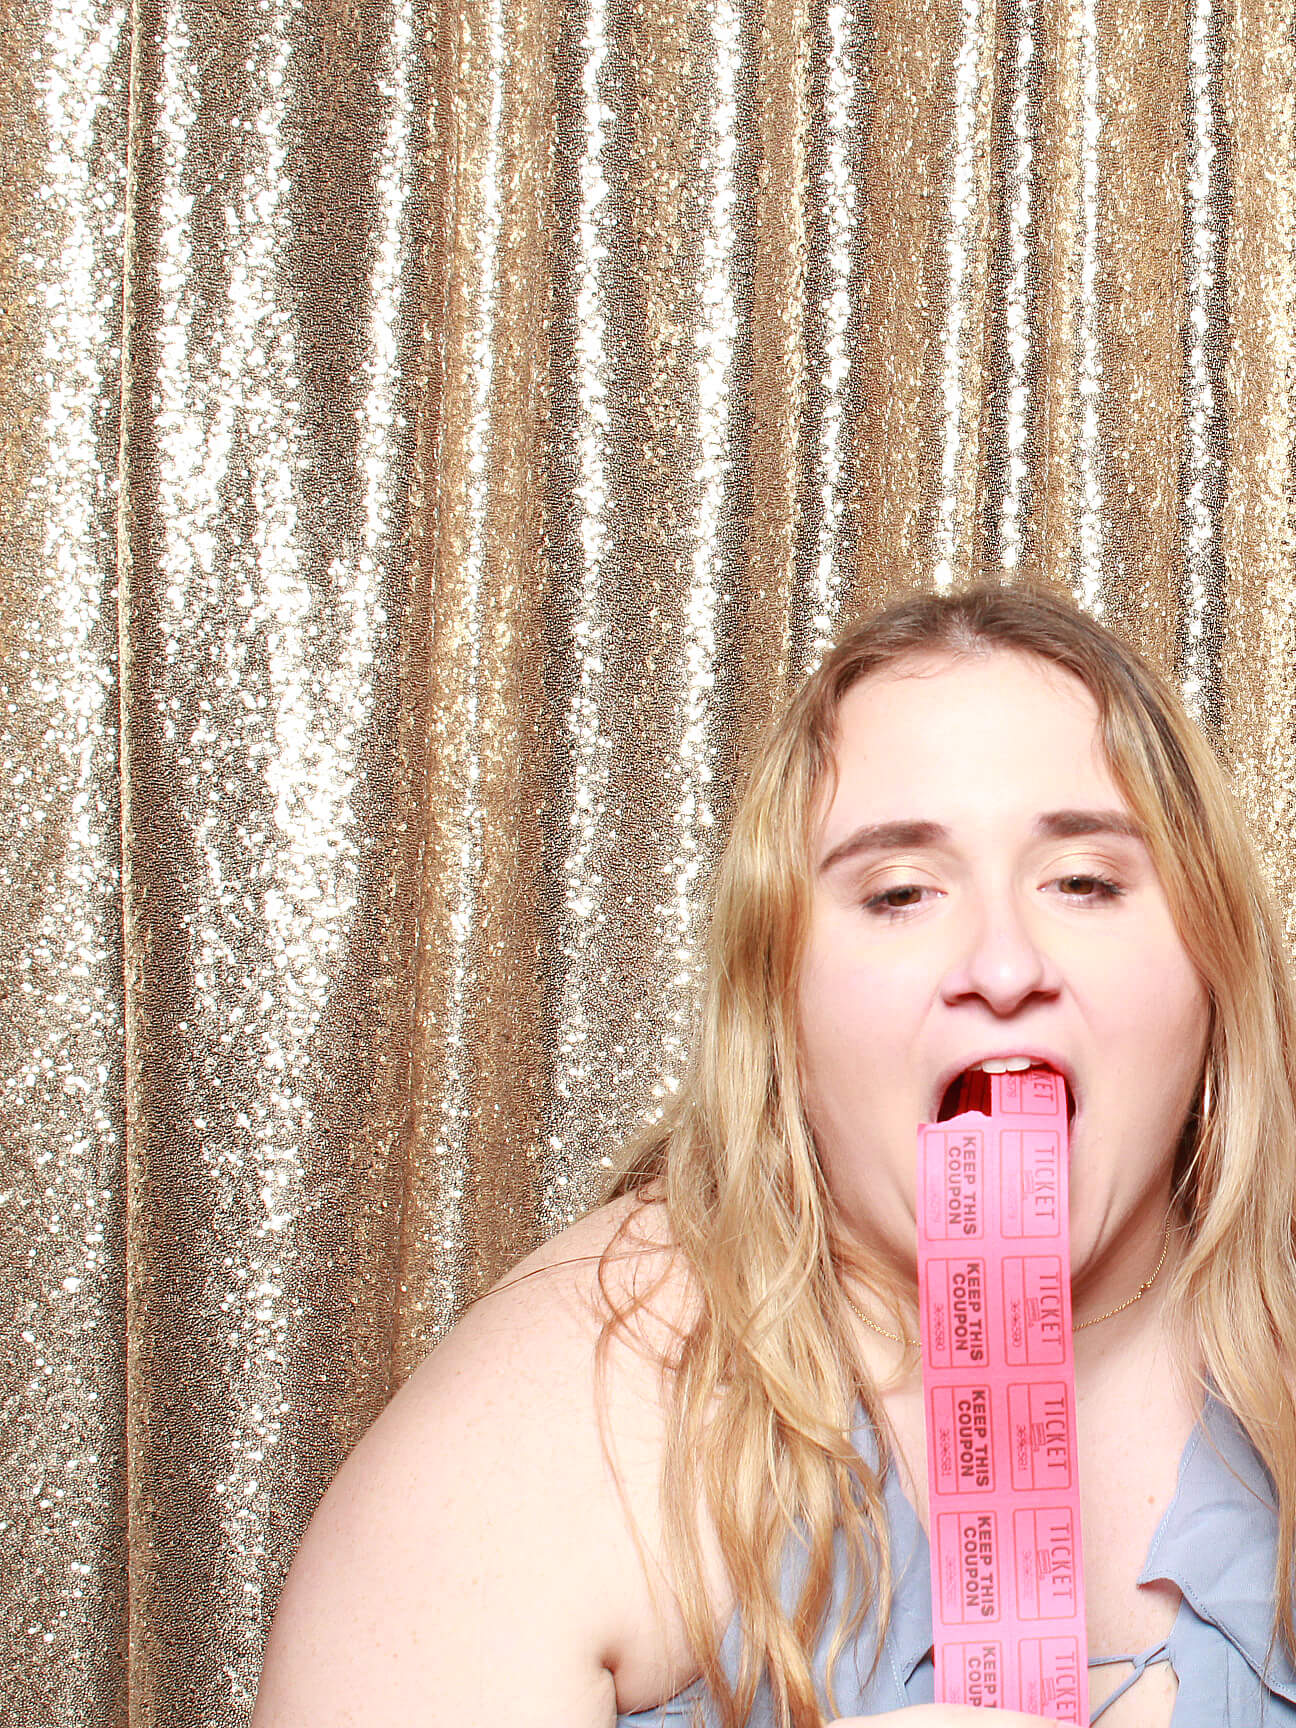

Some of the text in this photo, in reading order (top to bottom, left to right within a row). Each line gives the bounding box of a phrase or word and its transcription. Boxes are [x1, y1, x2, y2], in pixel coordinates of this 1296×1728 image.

[1030, 1070, 1054, 1102] KET
[949, 1146, 962, 1225] COUPON
[962, 1136, 977, 1236] KEEP THIS
[1035, 1145, 1055, 1221] TICKET
[952, 1273, 969, 1351] COUPON
[967, 1263, 983, 1361] KEEP THIS
[1039, 1272, 1063, 1345] TICKET
[958, 1400, 974, 1477] COUPON
[972, 1390, 989, 1487] KEEP THIS
[1044, 1397, 1067, 1471] TICKET
[964, 1527, 979, 1607] COUPON
[977, 1516, 994, 1617] KEEP THIS
[1050, 1523, 1073, 1600] TICKET
[968, 1656, 981, 1708] COUP
[982, 1647, 997, 1694] KEEP
[1055, 1651, 1079, 1723] TICKET
